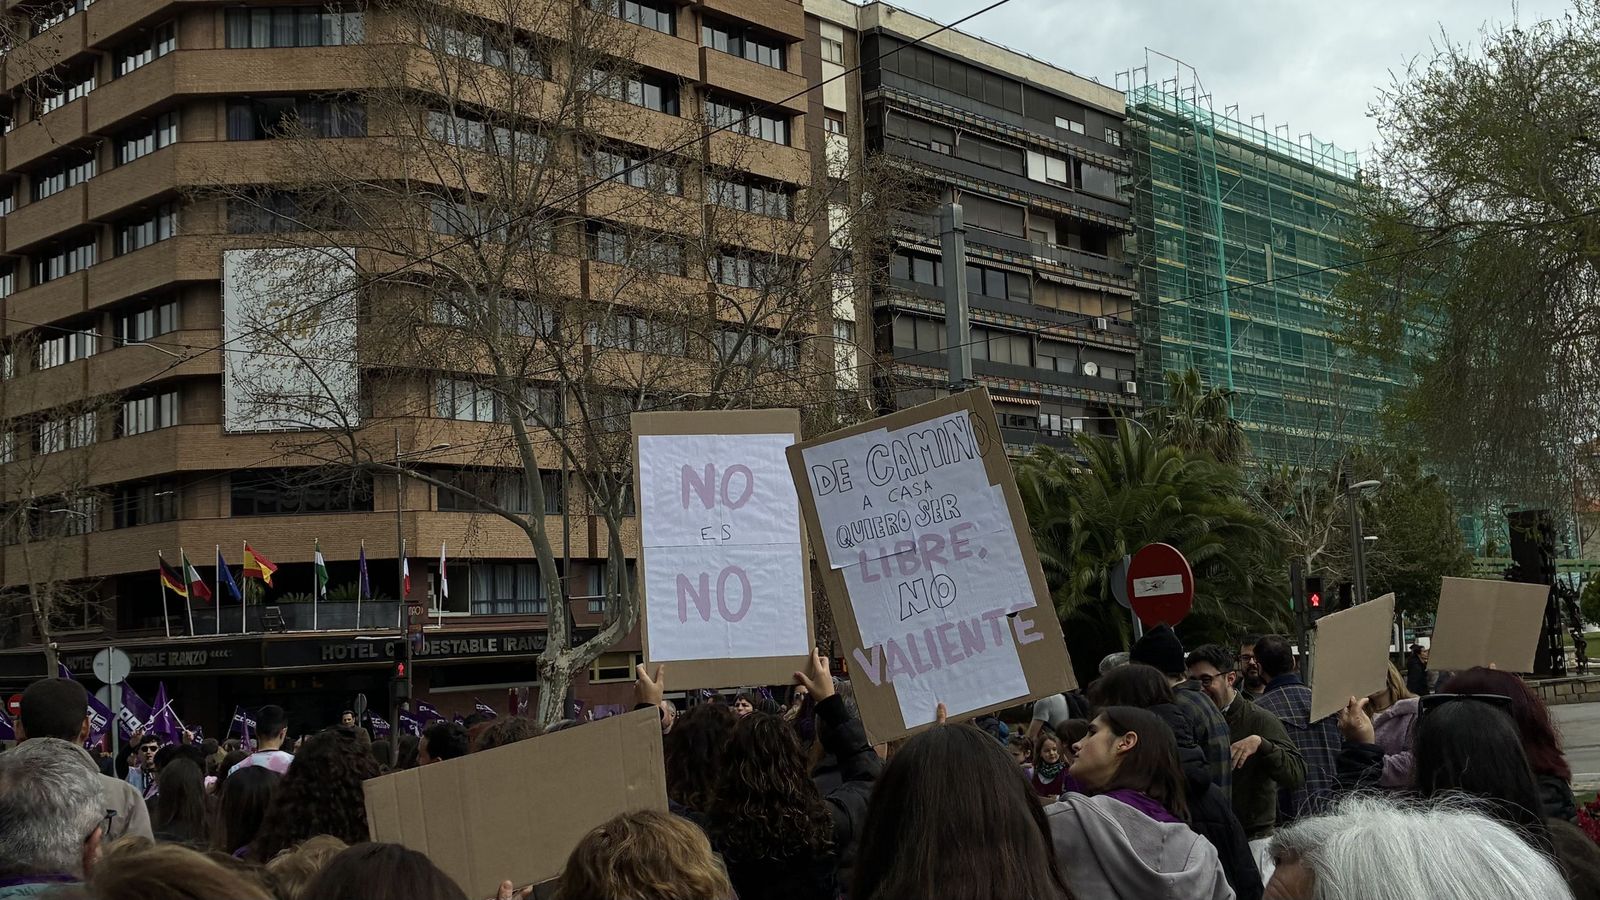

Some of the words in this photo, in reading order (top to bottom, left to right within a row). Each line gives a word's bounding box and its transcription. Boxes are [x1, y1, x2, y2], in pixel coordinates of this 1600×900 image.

[812, 459, 852, 496] DE
[866, 411, 991, 486] CAMINO
[681, 463, 753, 510] NO
[862, 495, 873, 510] A
[888, 480, 933, 503] CASA
[700, 524, 731, 540] ES
[836, 509, 912, 549] QUIERO
[915, 494, 961, 527] SER
[676, 565, 752, 624] NO
[899, 574, 957, 621] NO
[168, 650, 208, 667] IRANZO
[321, 643, 379, 661] HOTEL
[384, 638, 498, 657] CDESTABLE
[503, 635, 546, 651] IRANZ
[853, 602, 1044, 686] VALIENTE
